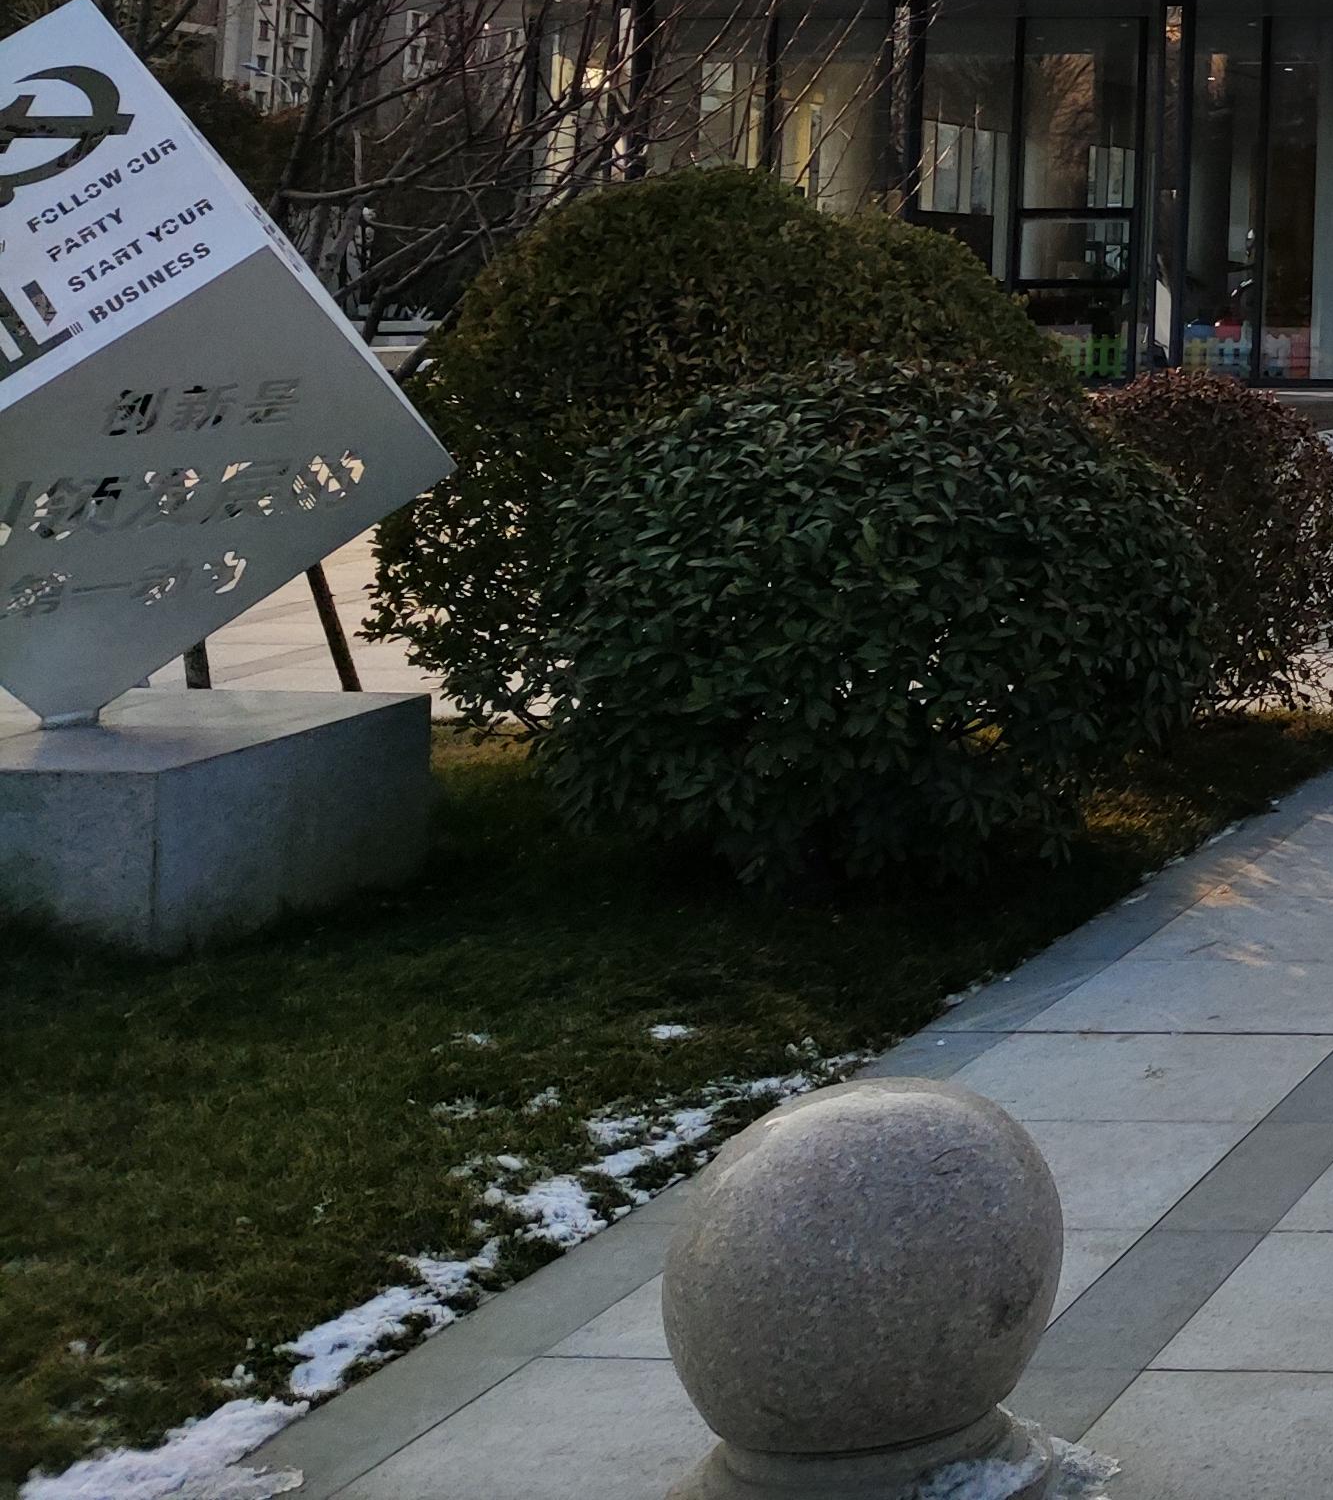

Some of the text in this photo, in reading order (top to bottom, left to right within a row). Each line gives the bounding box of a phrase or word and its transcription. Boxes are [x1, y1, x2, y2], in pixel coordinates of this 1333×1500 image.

[26, 168, 122, 233] FOLLOW
[126, 137, 179, 174] OUR
[46, 207, 125, 262] PARTY
[67, 238, 144, 293] START
[146, 197, 215, 243] YOUR
[88, 242, 212, 324] BUSINESS
